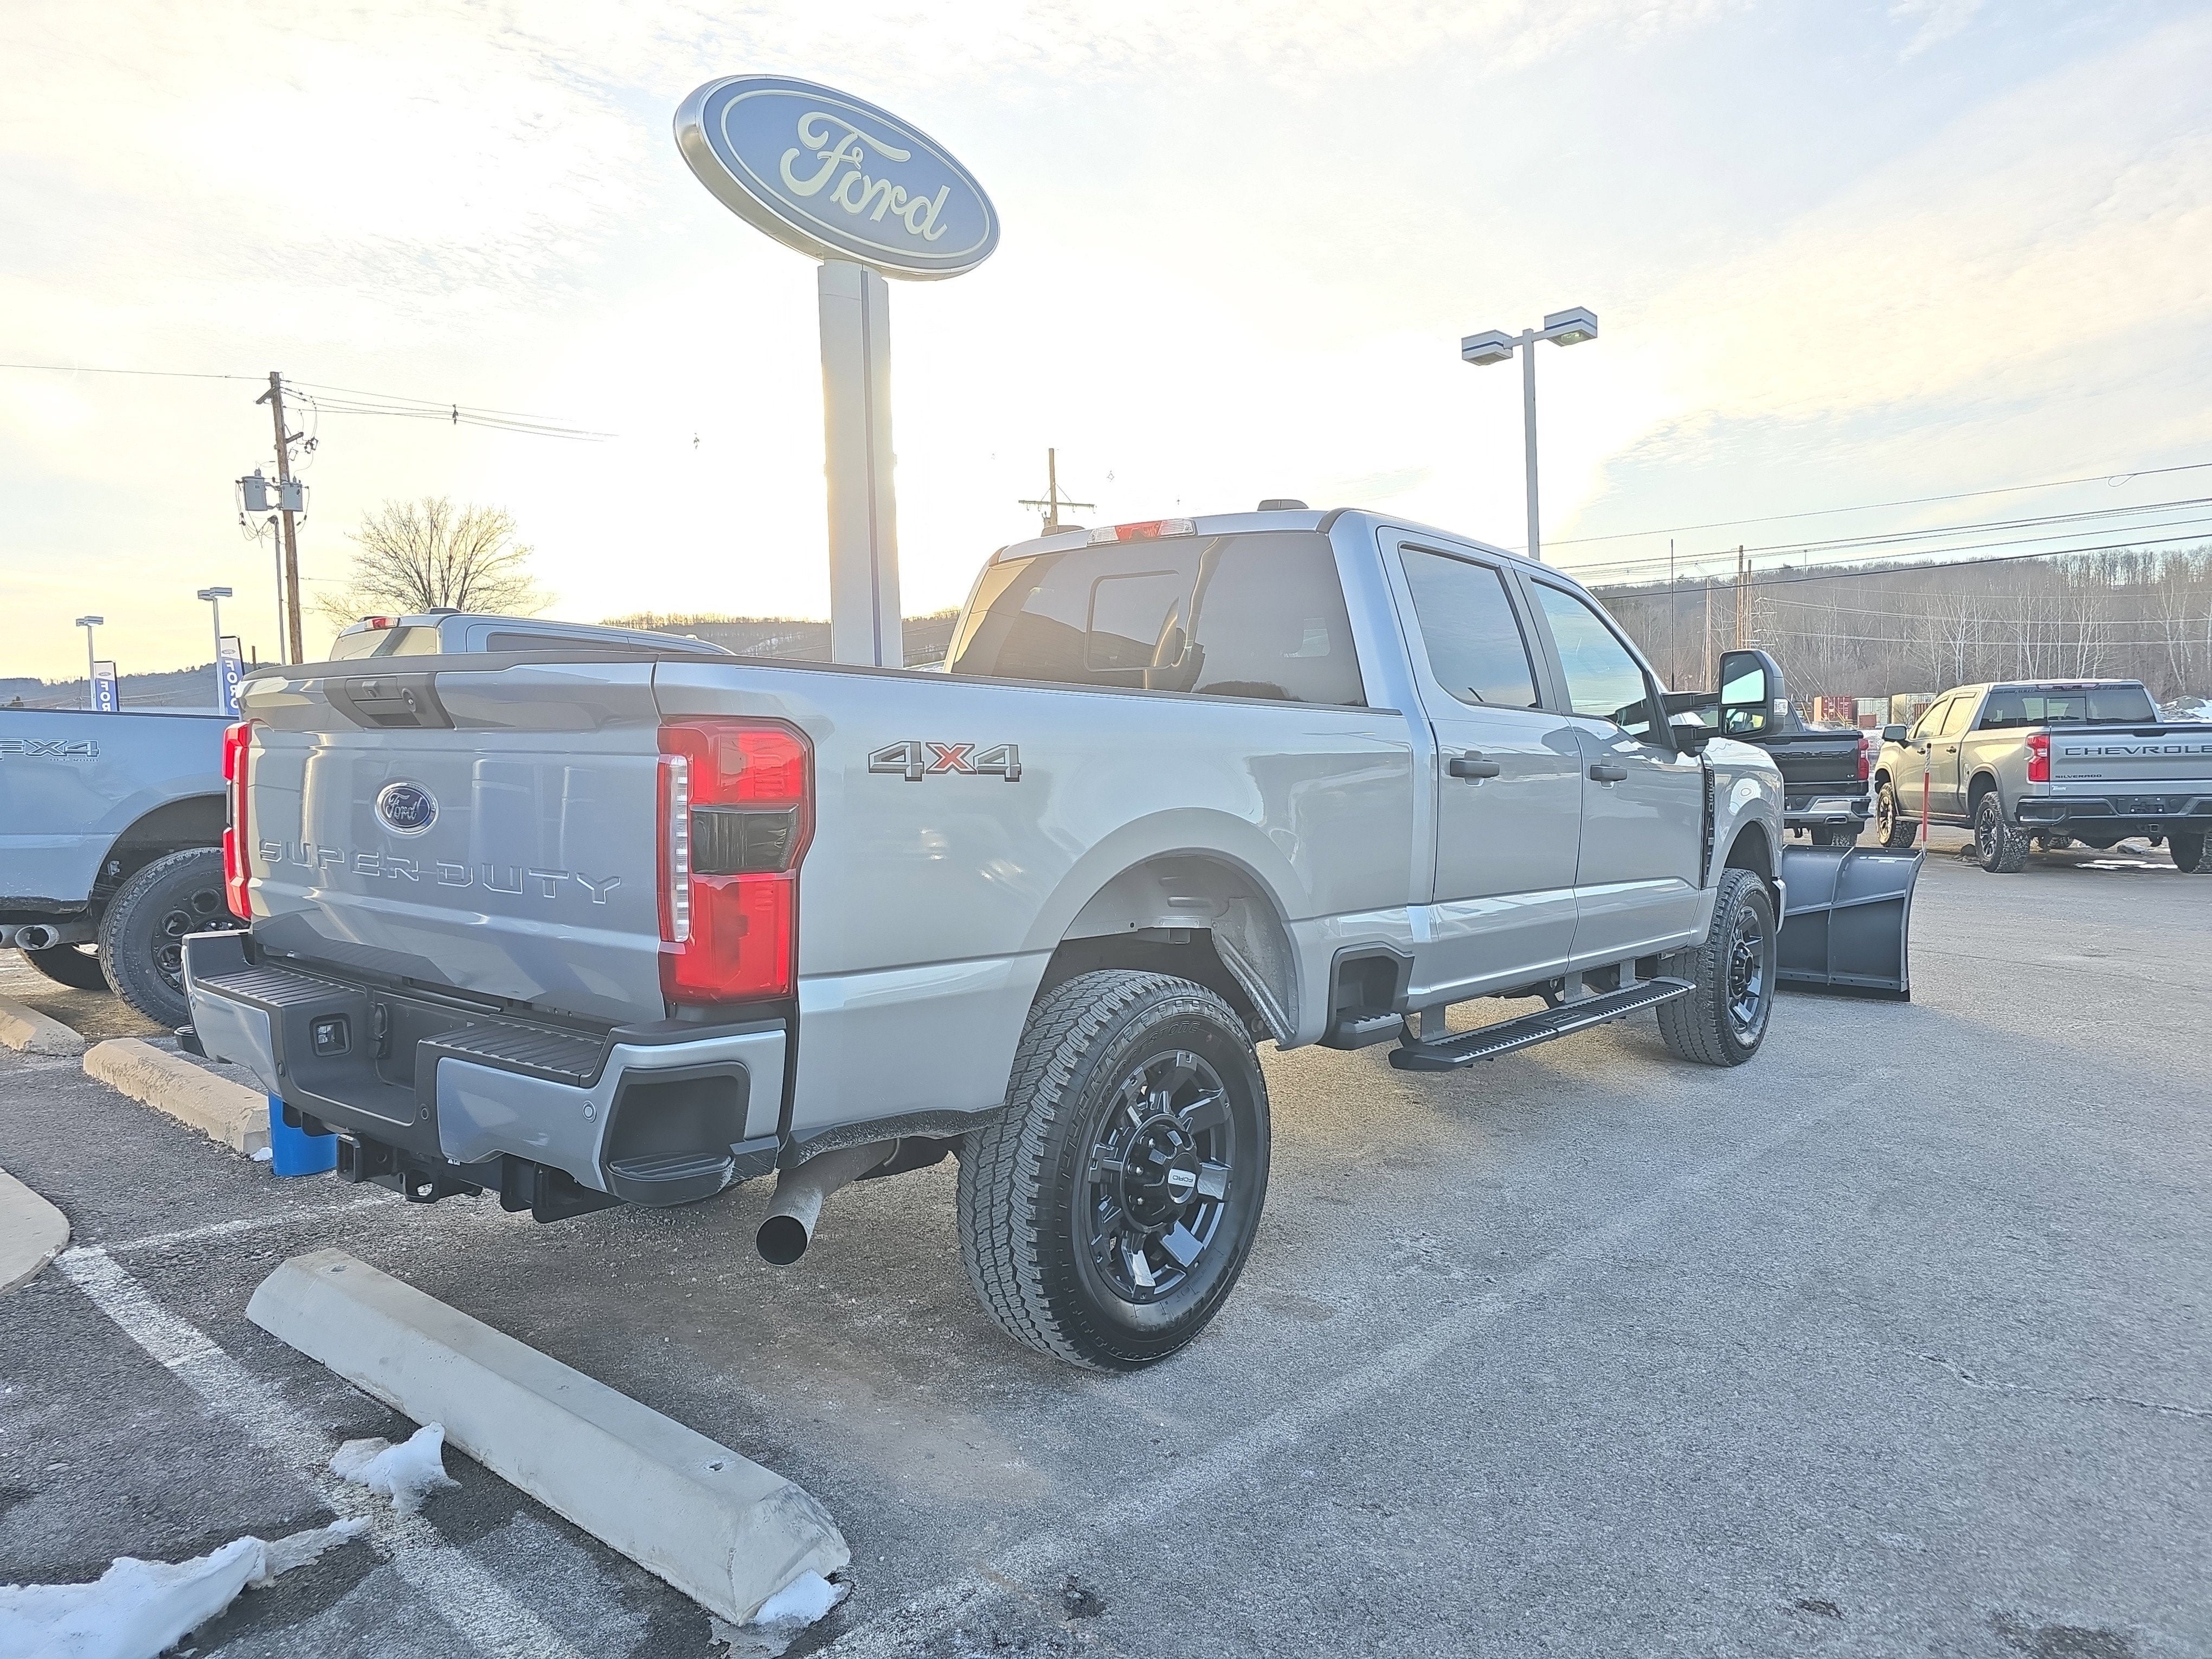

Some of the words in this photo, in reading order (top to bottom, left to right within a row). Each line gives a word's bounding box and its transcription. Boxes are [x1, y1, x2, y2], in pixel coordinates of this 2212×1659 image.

[780, 112, 950, 242] Ford
[0, 738, 100, 761] FX4
[867, 740, 1022, 782] 4X4
[2065, 745, 2212, 756] CHEVROLE
[385, 792, 423, 821] Ford
[259, 838, 420, 882] SUPER
[436, 859, 622, 905] DUTY
[1172, 1175, 1194, 1183] FORD
